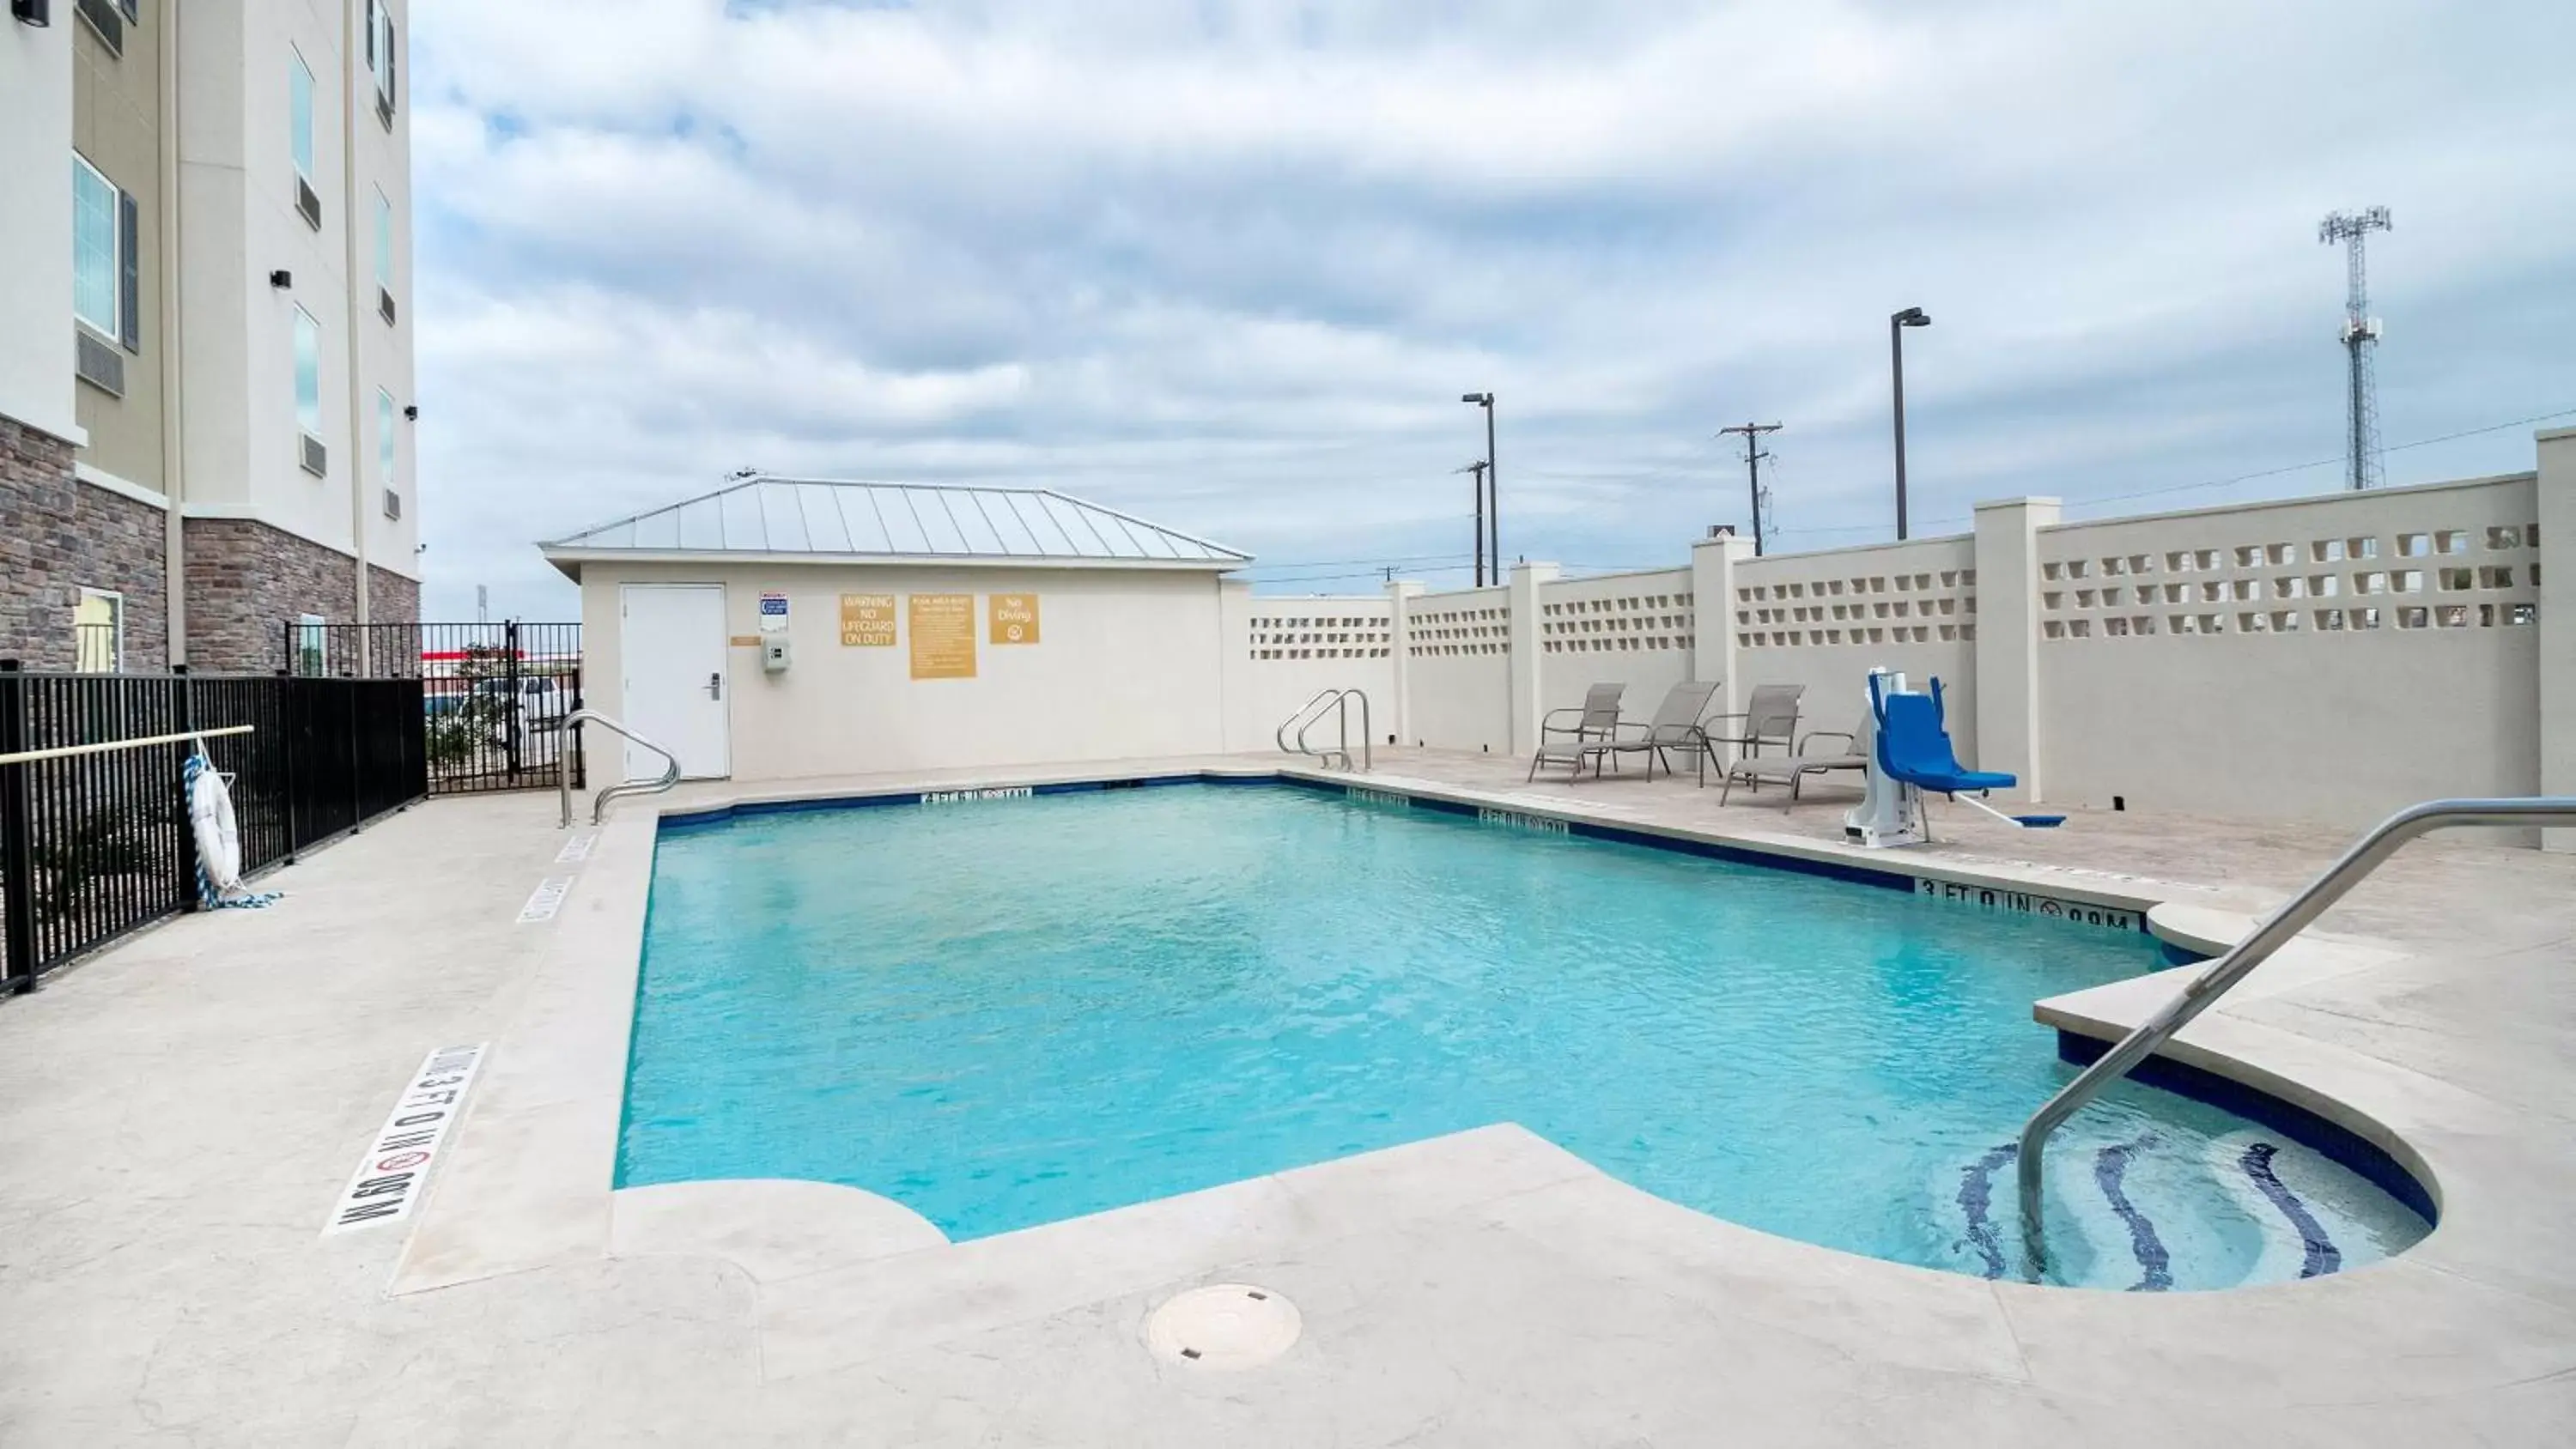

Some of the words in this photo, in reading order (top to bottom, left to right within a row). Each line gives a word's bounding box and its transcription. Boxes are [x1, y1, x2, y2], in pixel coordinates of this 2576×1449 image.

[845, 596, 893, 608] WARNING
[1005, 597, 1023, 608] No
[860, 609, 877, 620] NO
[998, 609, 1031, 623] Diving
[842, 621, 895, 633] LIFEGUARD
[845, 634, 862, 645] ON
[864, 634, 891, 645] DUTY
[1923, 879, 1935, 895] 3
[1945, 883, 1969, 902] FT
[404, 1089, 458, 1108] FT
[377, 1127, 438, 1153] IN
[337, 1197, 405, 1226] M
